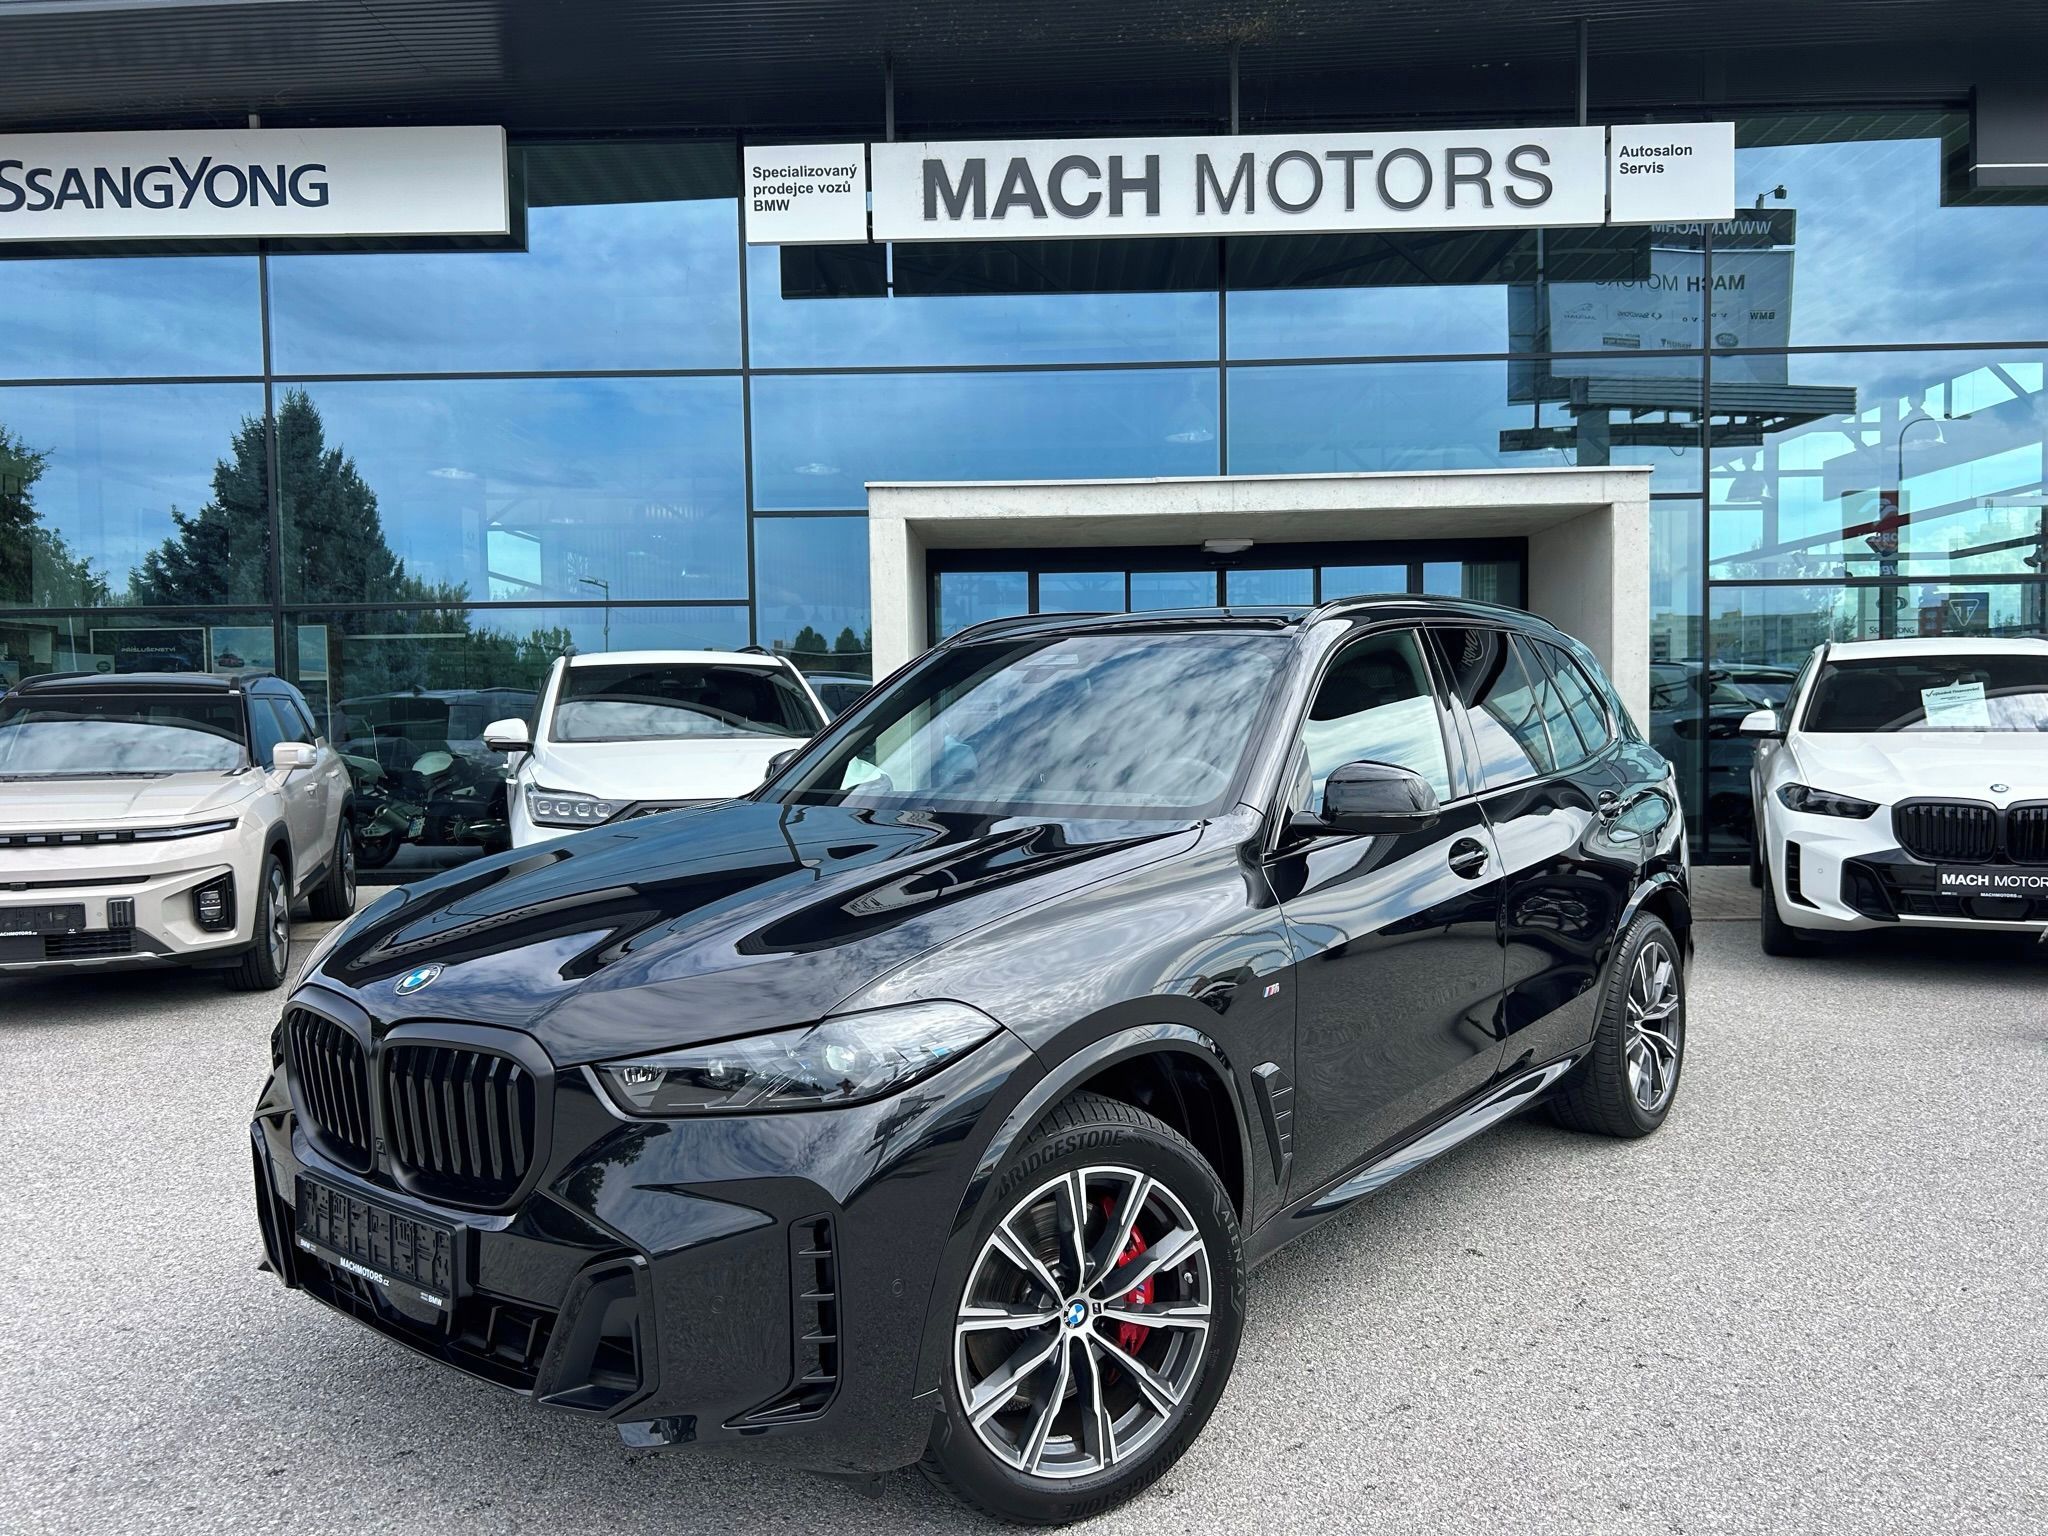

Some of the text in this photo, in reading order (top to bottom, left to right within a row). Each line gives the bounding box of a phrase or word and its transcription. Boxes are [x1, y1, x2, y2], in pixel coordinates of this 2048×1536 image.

[1619, 144, 1693, 158] Autosalon
[752, 164, 857, 181] Specializovaný
[1619, 162, 1665, 174] Servis
[753, 180, 851, 198] prodejce vozů
[922, 144, 1554, 221] MACH MOTORS
[754, 199, 790, 212] BMW
[1941, 873, 1989, 886] MACH
[998, 1129, 1125, 1198] BRIDGESTONE
[1221, 1210, 1245, 1296] ALENZA
